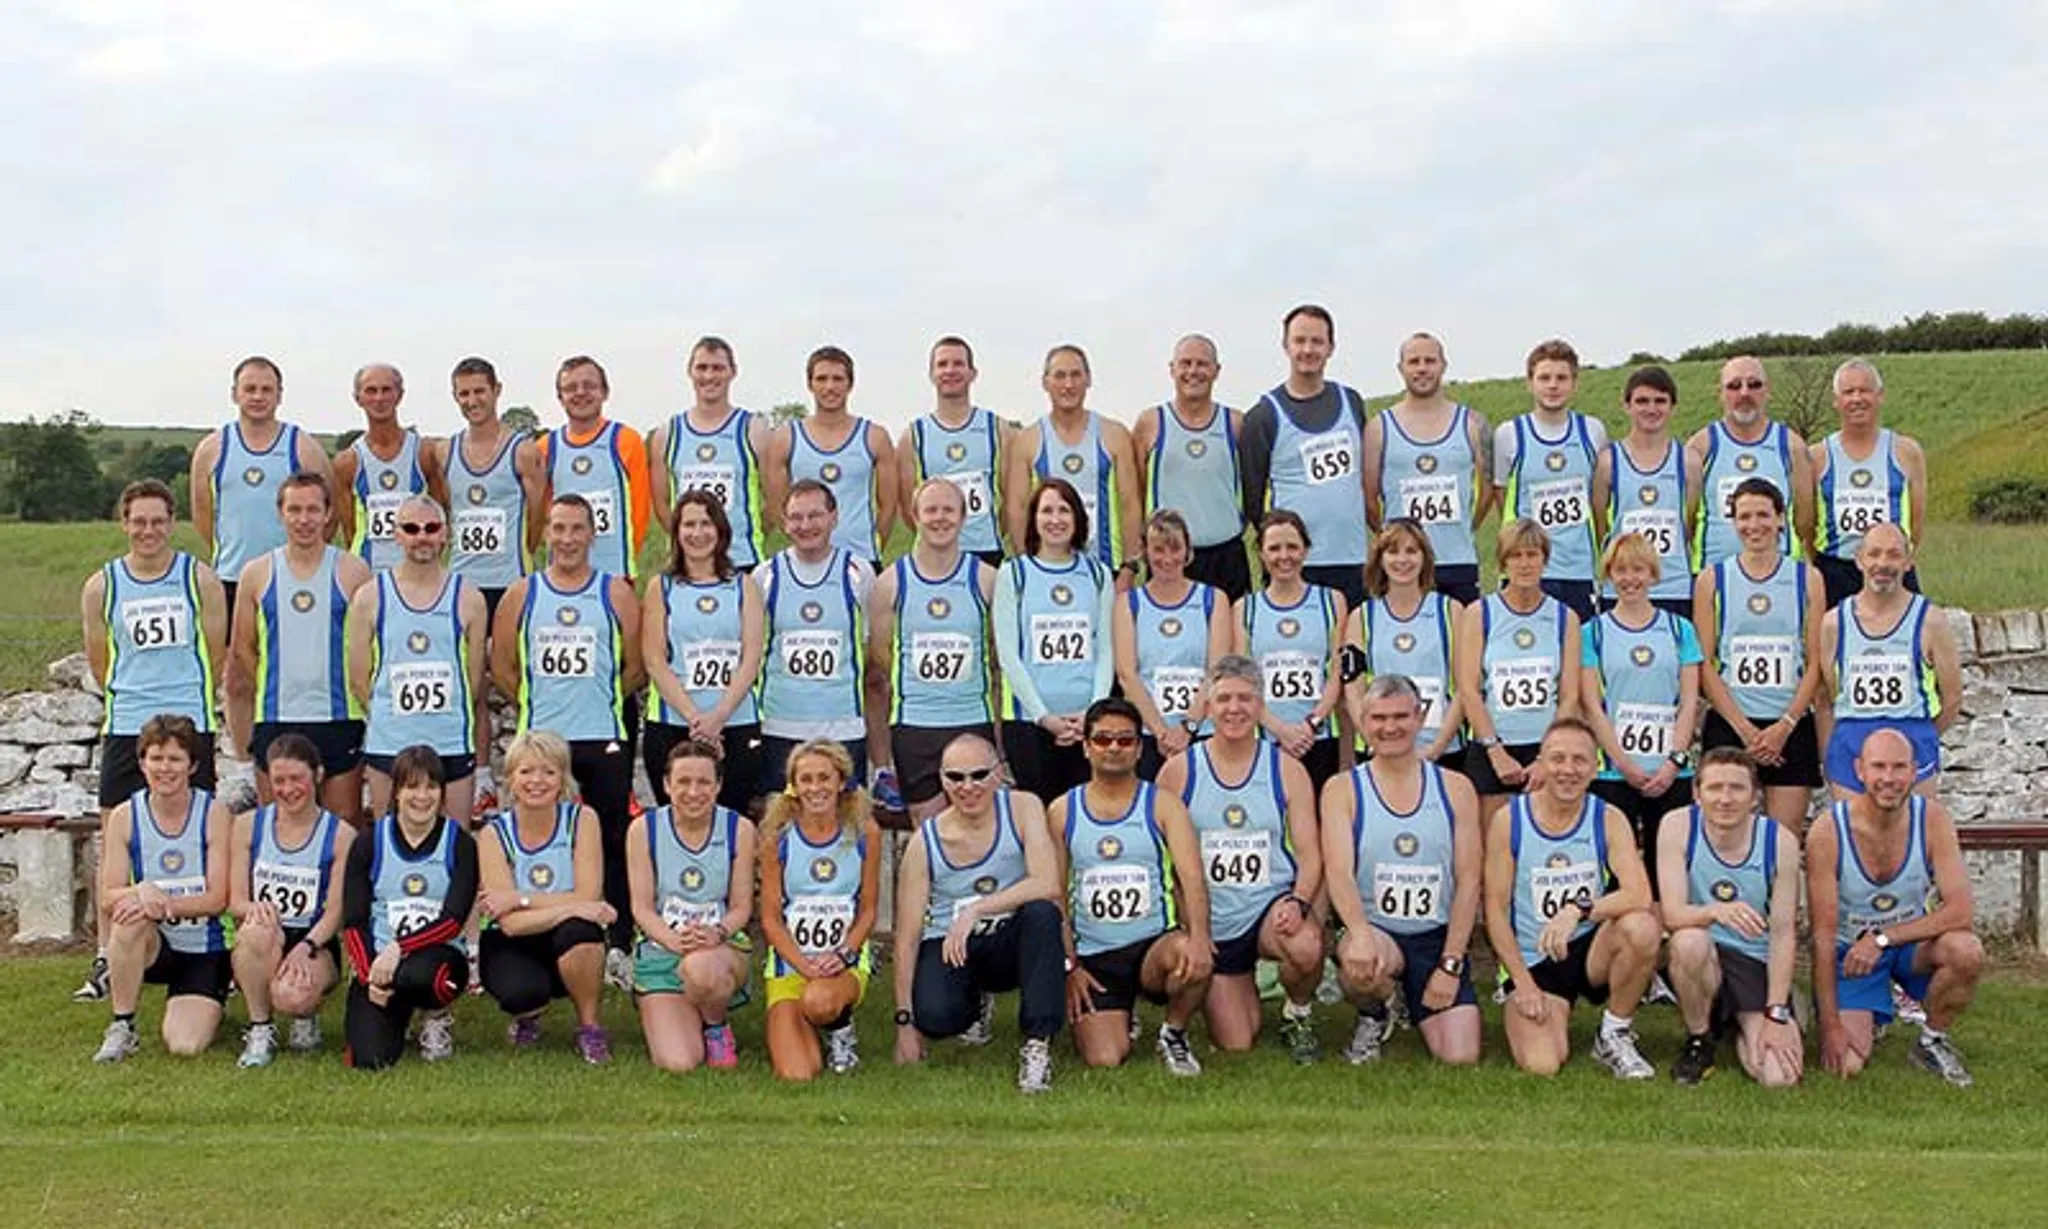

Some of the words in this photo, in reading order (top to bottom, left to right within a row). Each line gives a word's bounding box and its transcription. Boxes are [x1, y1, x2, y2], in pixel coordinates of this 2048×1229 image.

[1311, 450, 1350, 480] 659
[1410, 495, 1452, 521] 664
[1540, 496, 1581, 525] 683
[1840, 508, 1884, 532] 685
[372, 511, 395, 536] 65
[462, 526, 498, 551] 686
[134, 617, 176, 646] 651
[1040, 632, 1084, 660] 642
[542, 647, 587, 674] 665
[693, 660, 731, 687] 626
[788, 650, 834, 676] 680
[919, 653, 964, 680] 687
[1738, 657, 1781, 684] 681
[400, 682, 445, 711] 695
[1271, 671, 1314, 698] 653
[1502, 678, 1548, 707] 635
[1853, 676, 1902, 705] 638
[1162, 686, 1199, 712] 53
[1622, 724, 1663, 753] 661
[1211, 853, 1261, 883] 649
[258, 883, 307, 917] 639
[1091, 888, 1141, 919] 682
[1381, 886, 1431, 916] 613
[796, 917, 843, 947] 668
